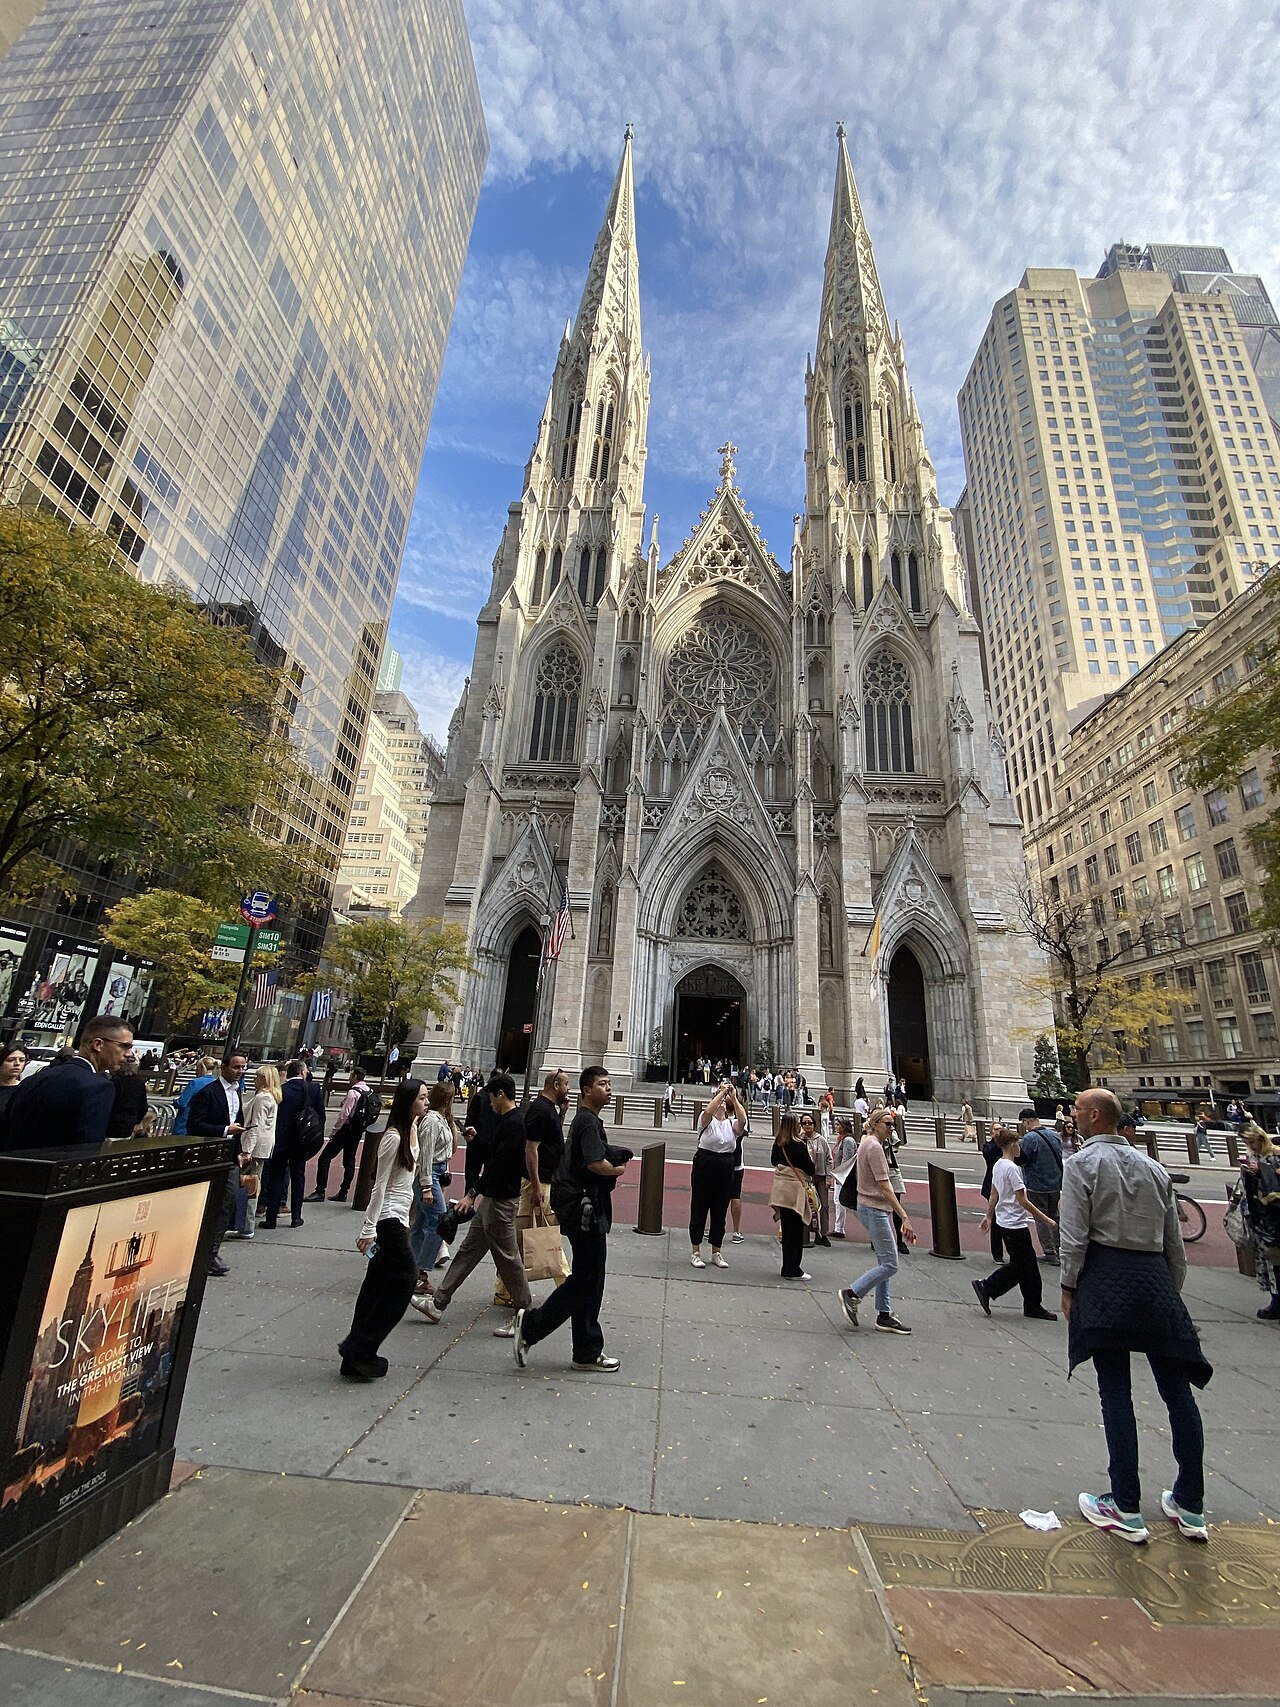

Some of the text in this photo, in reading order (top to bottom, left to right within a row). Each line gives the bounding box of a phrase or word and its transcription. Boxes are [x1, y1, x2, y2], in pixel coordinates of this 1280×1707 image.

[257, 942, 277, 951] SIM31
[259, 932, 280, 941] SIM10
[101, 1278, 147, 1301] INTRODUCING
[49, 1279, 177, 1369] SKYLIFT
[56, 1342, 154, 1398] THE GREATEST VIEW
[77, 1335, 142, 1374] WELCOME TO
[68, 1364, 139, 1407] IN THE WORLD
[59, 1493, 71, 1506] TOP
[91, 1470, 108, 1485] ROCK
[878, 1549, 1007, 1575] AVENUE
